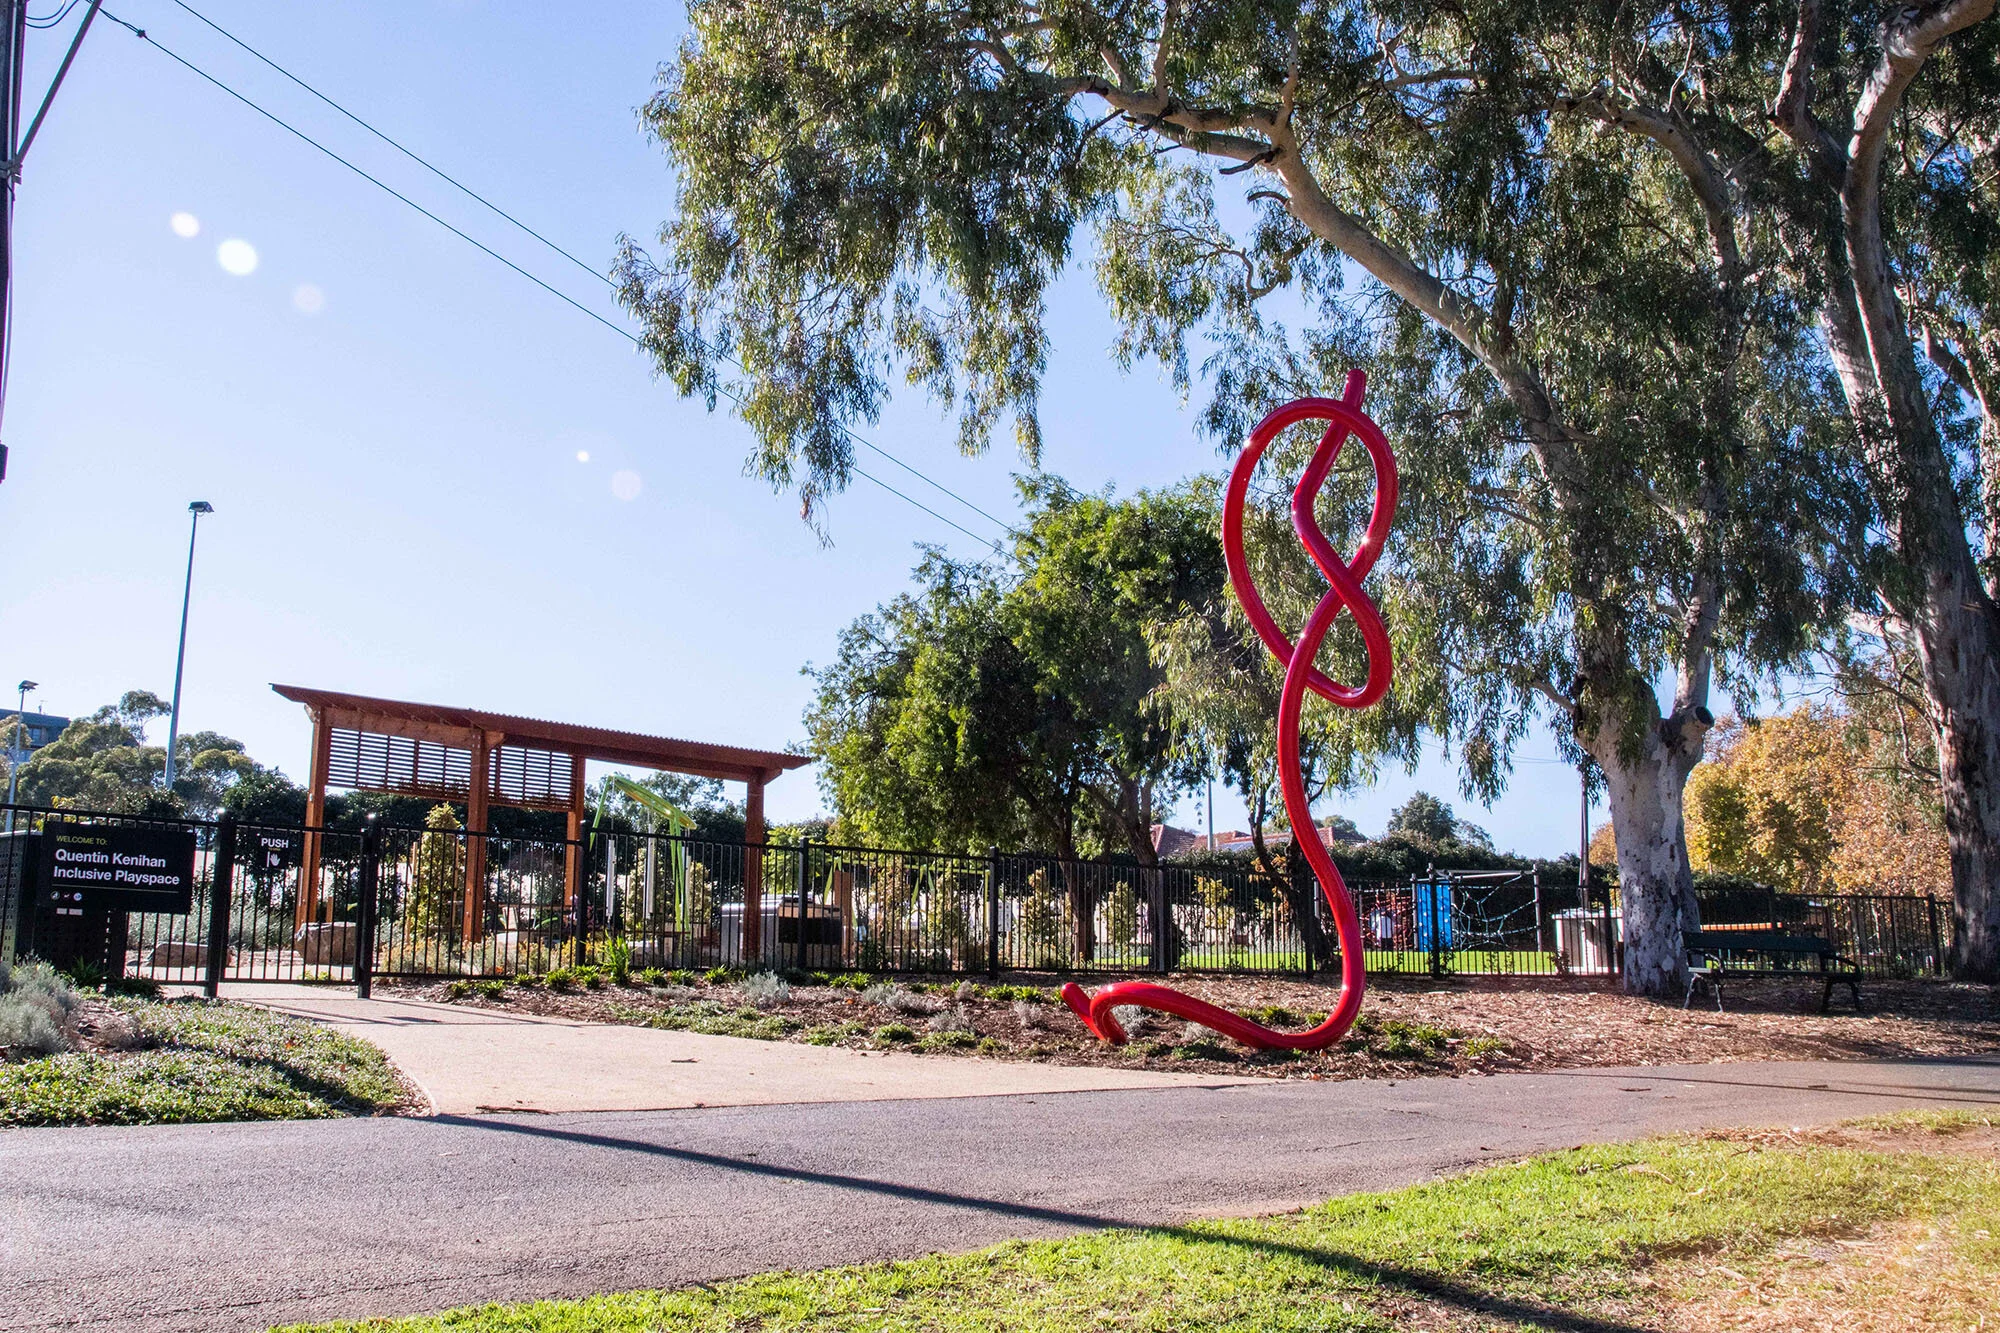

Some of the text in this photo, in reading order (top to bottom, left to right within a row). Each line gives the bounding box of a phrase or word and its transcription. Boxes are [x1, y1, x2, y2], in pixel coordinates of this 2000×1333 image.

[56, 835, 107, 846] WELCOME TO:
[261, 838, 289, 848] PUSH
[55, 848, 166, 868] Quentin Kenihan
[53, 865, 180, 886] Inclusive Playspace
